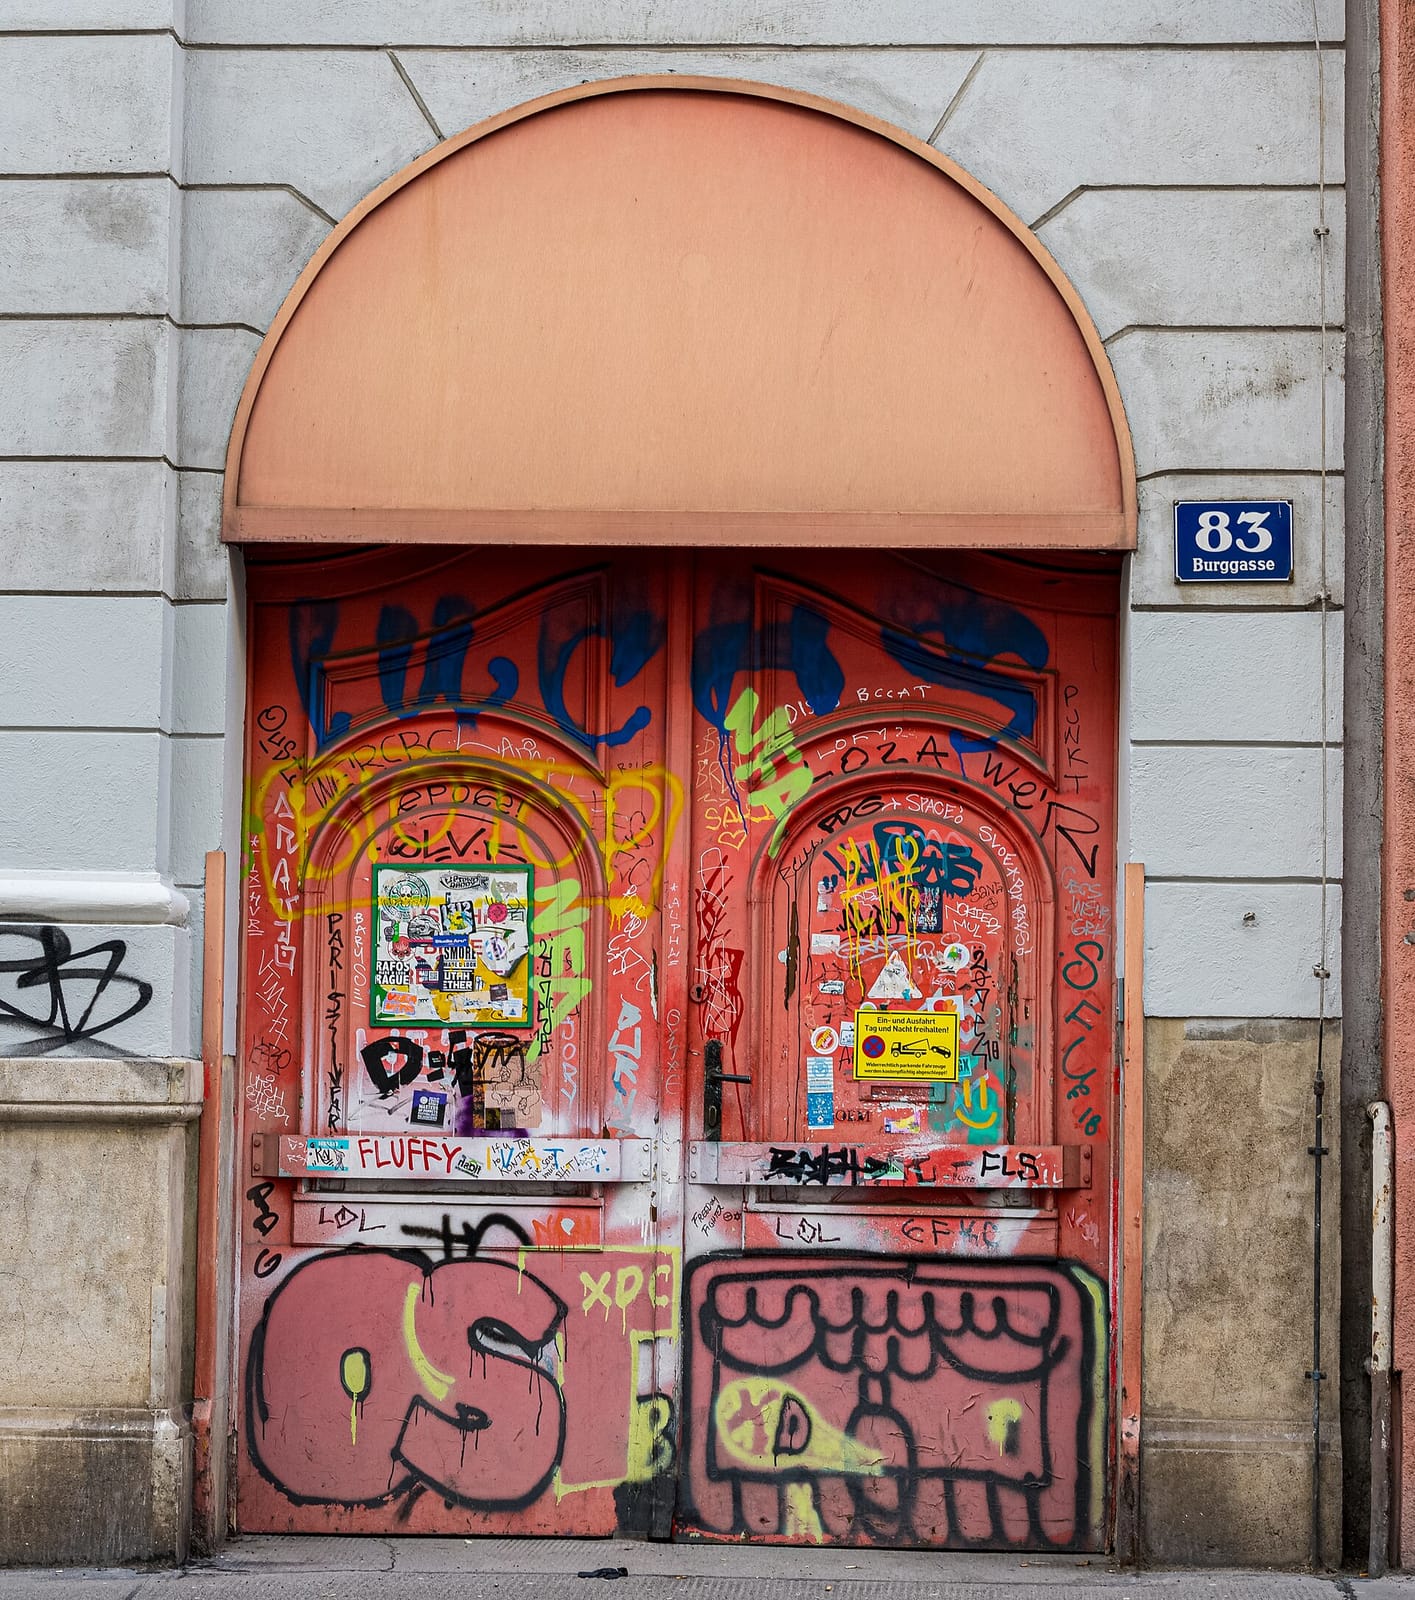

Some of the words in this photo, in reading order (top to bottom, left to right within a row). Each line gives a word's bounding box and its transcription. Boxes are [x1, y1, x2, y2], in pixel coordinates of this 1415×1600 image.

[1195, 510, 1273, 553] 83
[1192, 557, 1275, 574] Burggasse
[864, 1024, 877, 1032] Tag
[893, 1025, 912, 1033] Nacht
[913, 1026, 949, 1034] freihalten!
[877, 1016, 891, 1024] Ein-
[906, 1017, 936, 1025] Ausfahrt
[357, 1138, 463, 1173] FLUFFY
